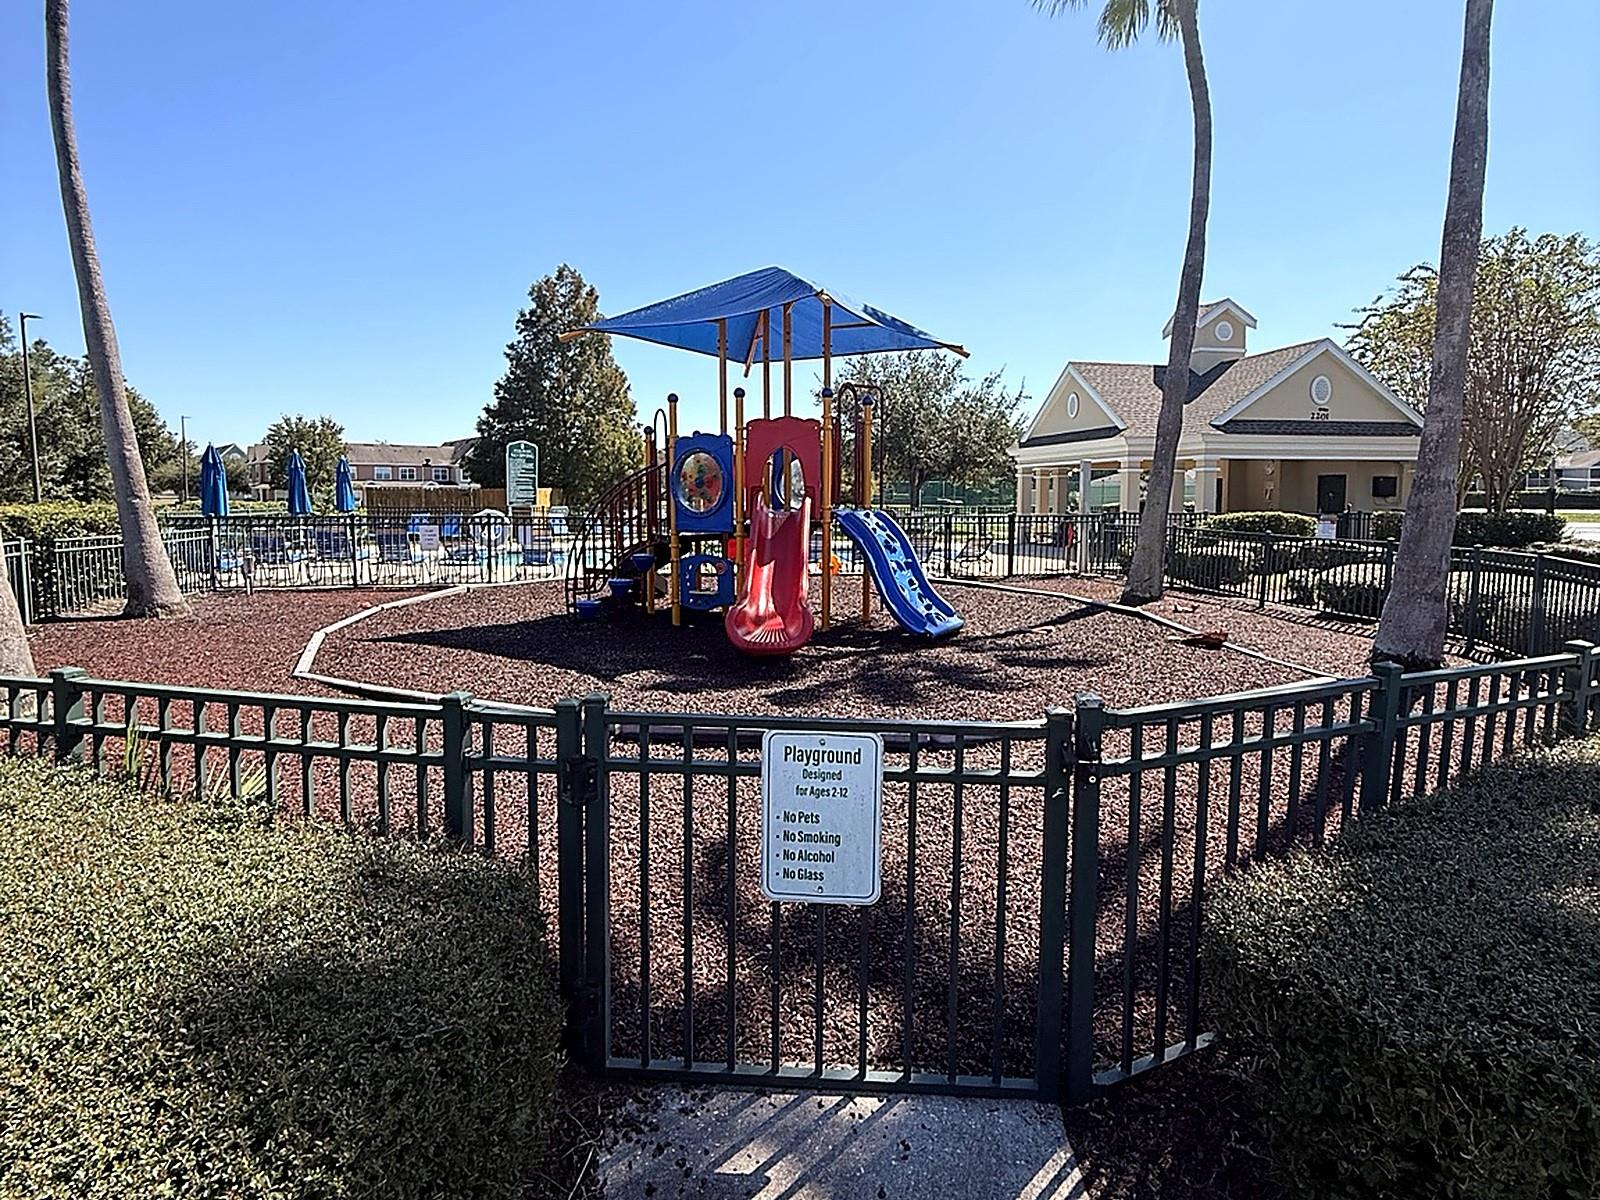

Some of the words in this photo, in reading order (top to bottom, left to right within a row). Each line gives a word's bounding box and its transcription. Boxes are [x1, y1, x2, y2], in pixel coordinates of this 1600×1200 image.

[784, 745, 862, 767] Playground
[802, 768, 842, 782] Designed
[795, 784, 808, 796] for
[808, 786, 830, 799] Ages
[831, 786, 848, 798] 2-12
[783, 811, 797, 823] No
[798, 811, 820, 824] Pets
[783, 830, 797, 842] No
[797, 831, 841, 847] Smoking
[782, 849, 796, 861] No
[797, 849, 835, 863] Alcohol
[782, 868, 796, 880] No
[797, 868, 825, 881] Glass
